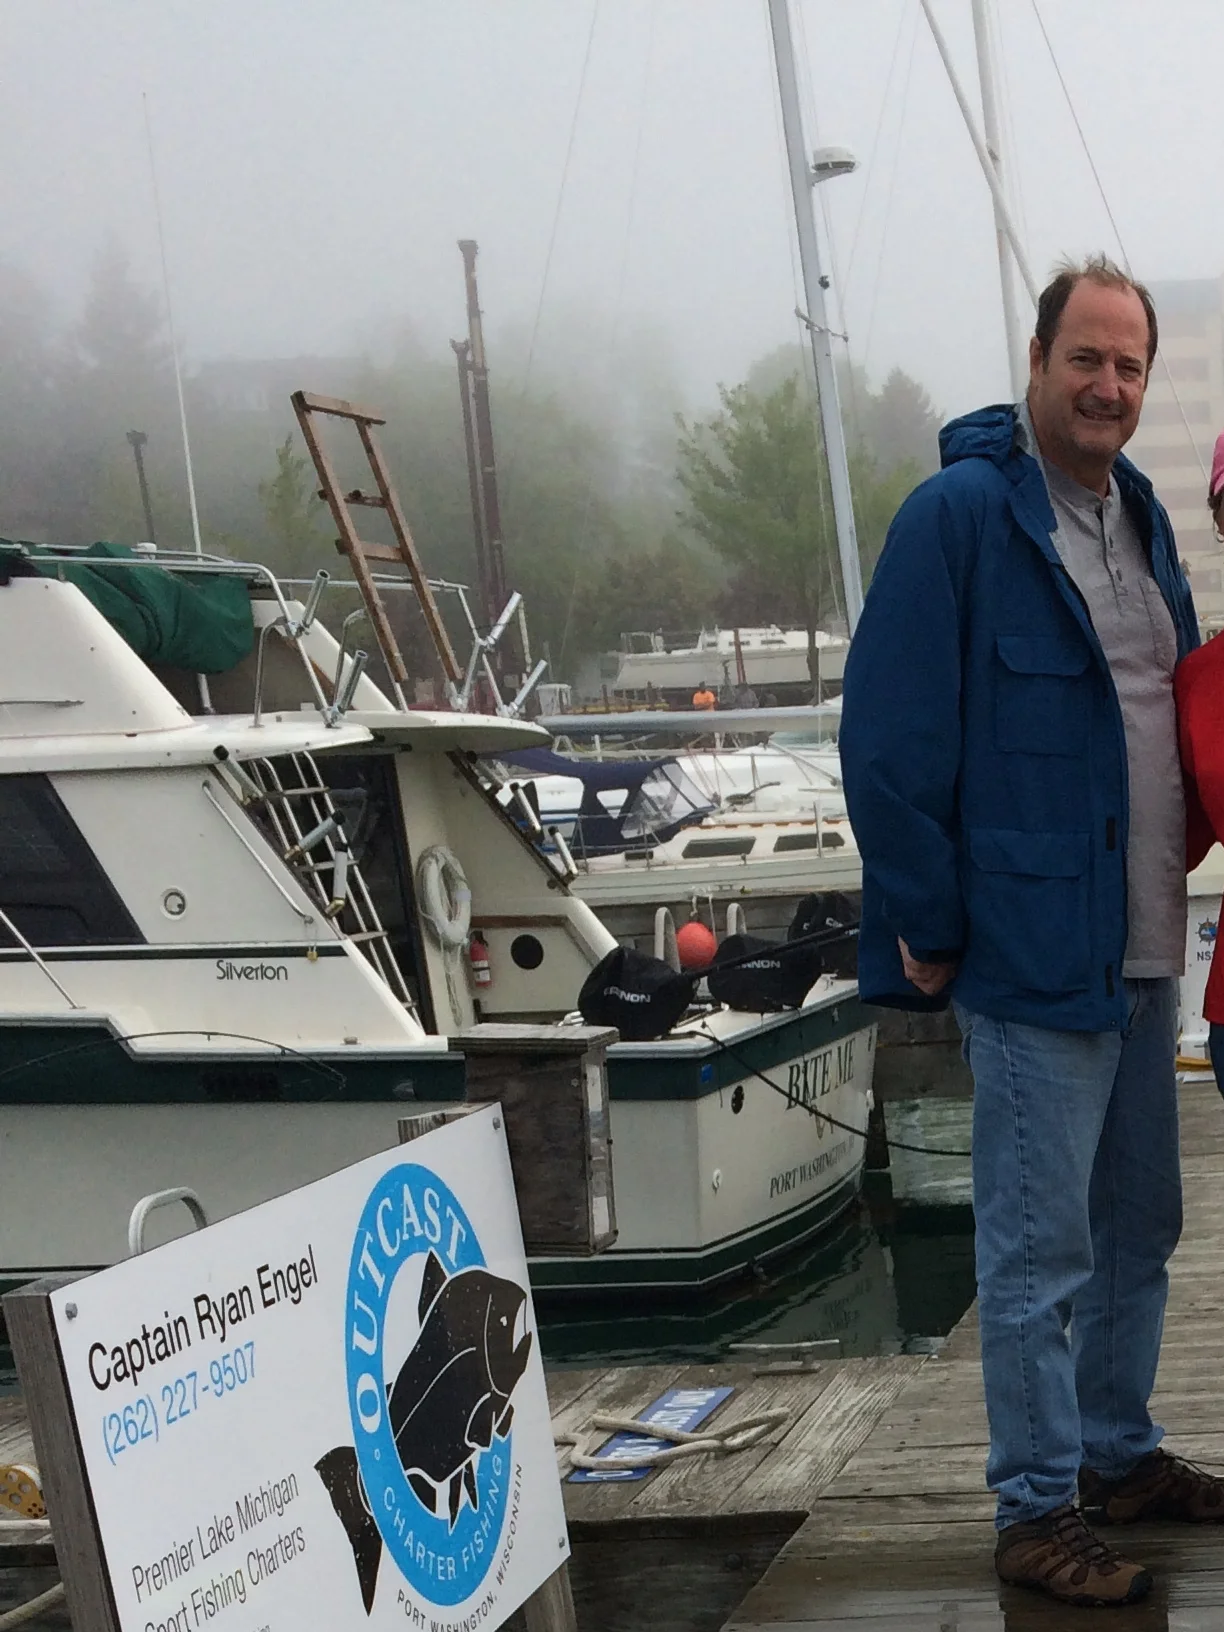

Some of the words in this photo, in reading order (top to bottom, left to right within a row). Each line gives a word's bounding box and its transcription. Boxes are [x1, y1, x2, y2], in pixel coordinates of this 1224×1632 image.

[216, 959, 288, 981] Silverton
[769, 1168, 799, 1199] PORT
[88, 1310, 192, 1392] Captain
[193, 1284, 256, 1343] Ryan
[256, 1243, 319, 1310] Engel
[352, 1182, 467, 1434] OUTCAST
[102, 1393, 160, 1466] (262)
[161, 1340, 256, 1425] 227-9507
[131, 1538, 196, 1604] Premier
[196, 1514, 236, 1560] Lake
[235, 1472, 300, 1535] Michigan
[190, 1568, 247, 1628] Fishing
[246, 1526, 306, 1586] Charters
[383, 1486, 457, 1581] CHARTER
[461, 1454, 503, 1573] FISHING
[397, 1588, 427, 1630] PORT
[495, 1463, 523, 1587] WISCONSIN
